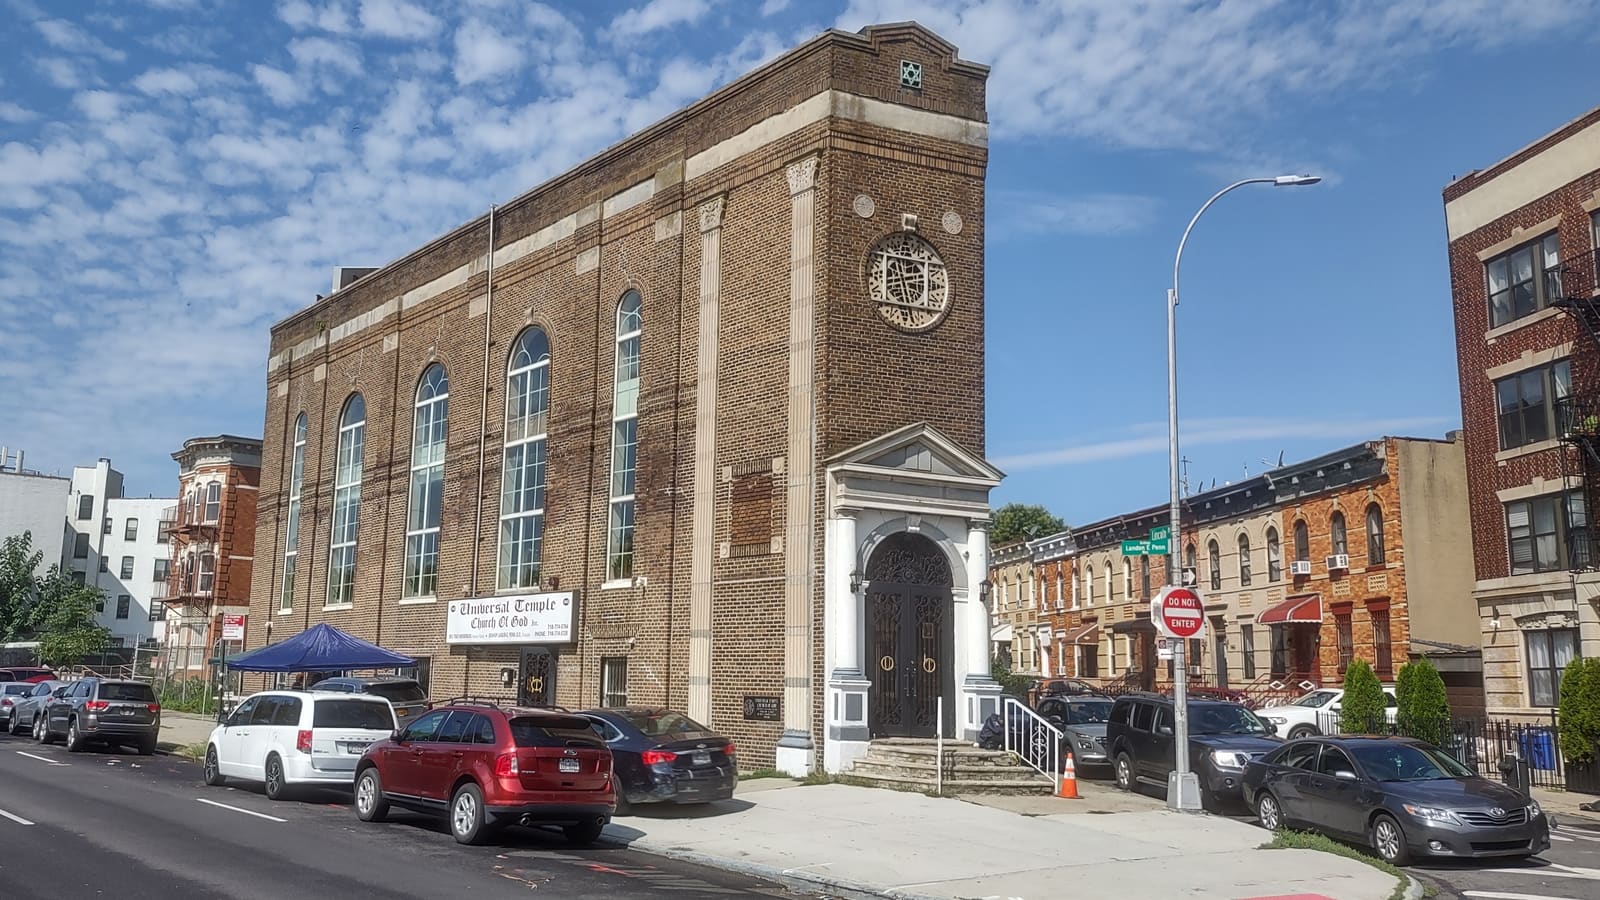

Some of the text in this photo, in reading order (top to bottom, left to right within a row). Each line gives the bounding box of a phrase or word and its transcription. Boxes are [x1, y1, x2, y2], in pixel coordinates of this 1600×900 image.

[1125, 544, 1145, 552] Landon
[460, 601, 509, 615] Universal
[514, 598, 556, 613] Temple
[1169, 598, 1196, 607] DO NOT
[470, 616, 496, 629] Church
[498, 616, 509, 628] Of
[510, 615, 528, 628] God
[1171, 619, 1195, 628] ENTER
